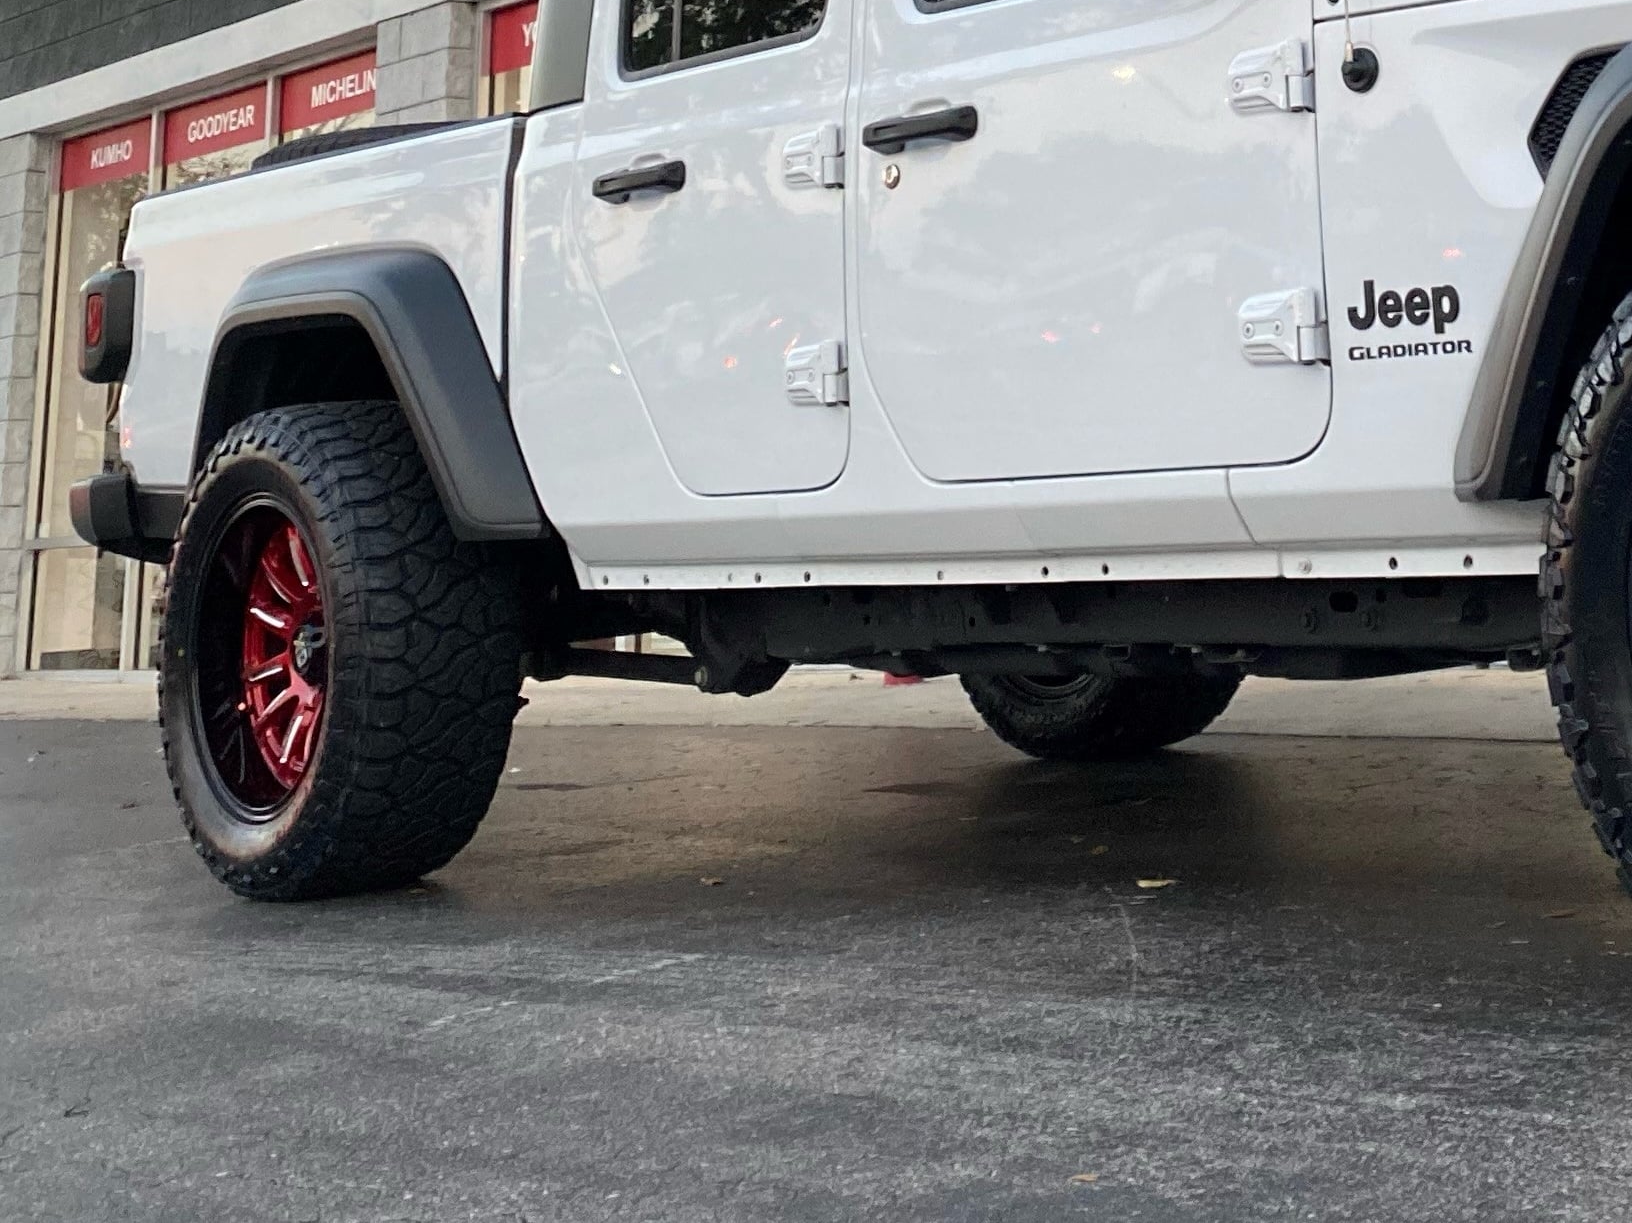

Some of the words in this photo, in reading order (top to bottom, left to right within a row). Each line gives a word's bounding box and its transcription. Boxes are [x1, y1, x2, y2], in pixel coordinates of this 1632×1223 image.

[311, 68, 377, 109] MICHELIN
[187, 104, 256, 144] GOODYEAR
[90, 139, 133, 170] KUMHO
[1346, 279, 1461, 335] Jeep
[1348, 339, 1473, 361] GLADIATOR
